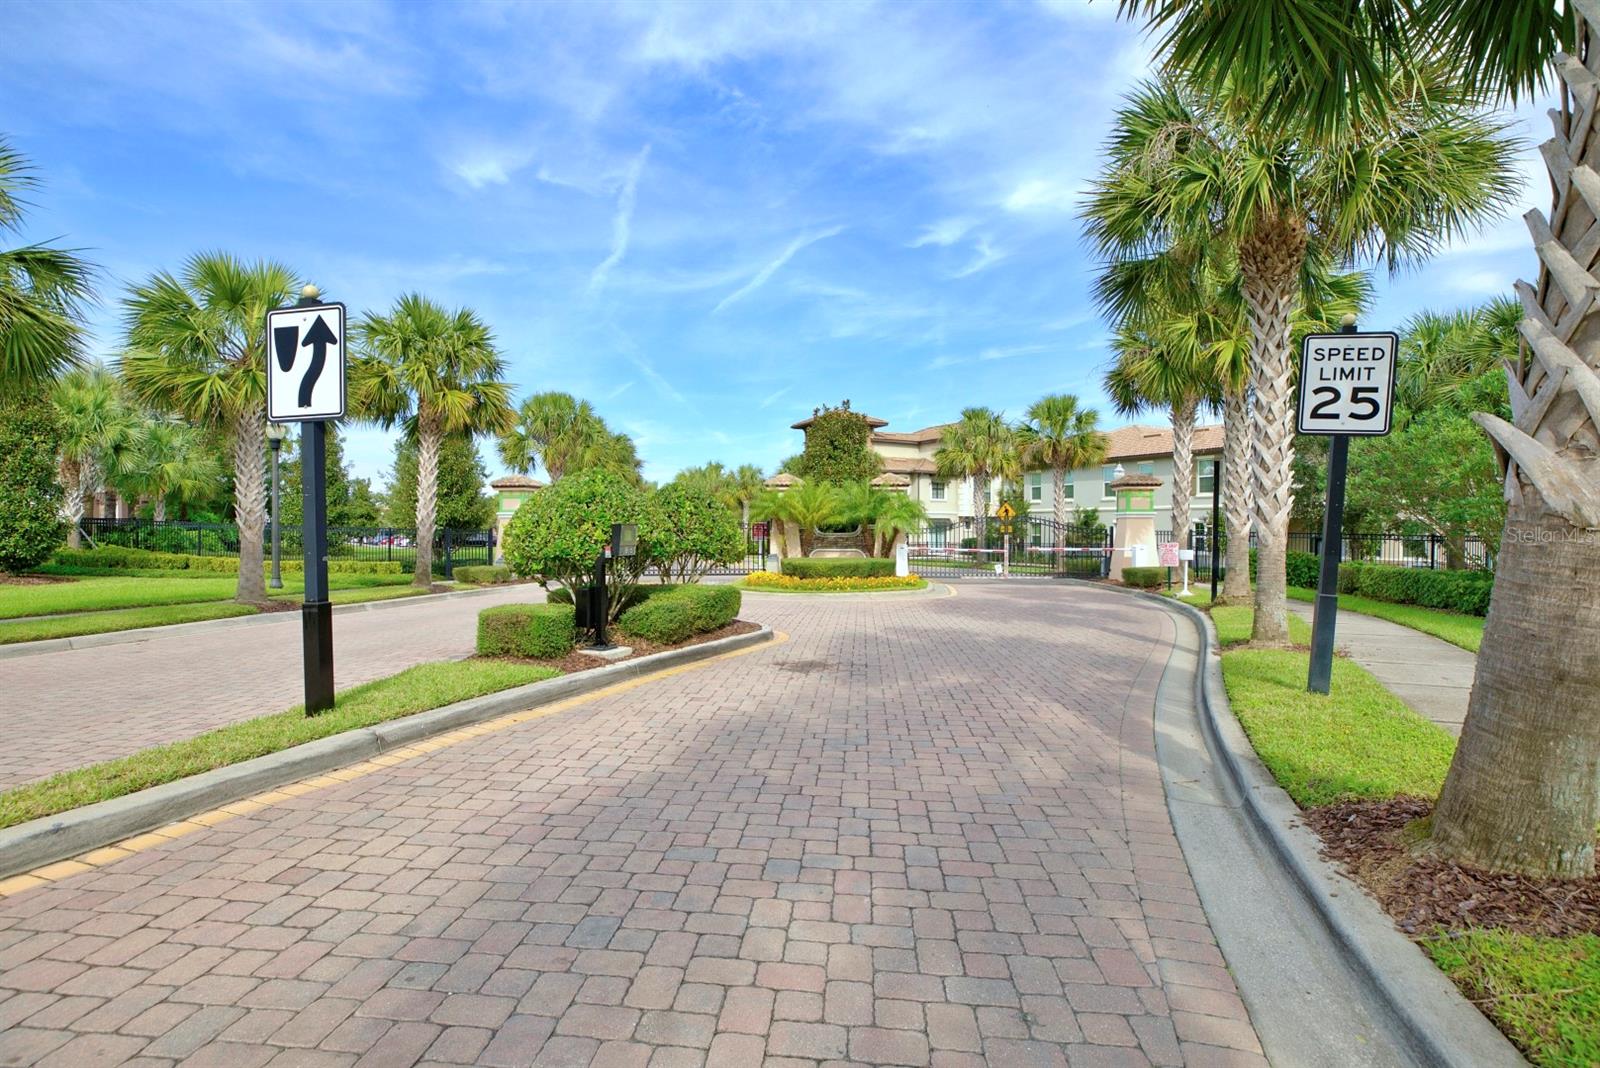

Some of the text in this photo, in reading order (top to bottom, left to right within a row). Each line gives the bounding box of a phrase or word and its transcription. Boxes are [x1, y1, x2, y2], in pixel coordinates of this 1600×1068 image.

[1313, 347, 1385, 361] SPEED
[1319, 367, 1376, 381] LIMIT
[1309, 386, 1380, 420] 25
